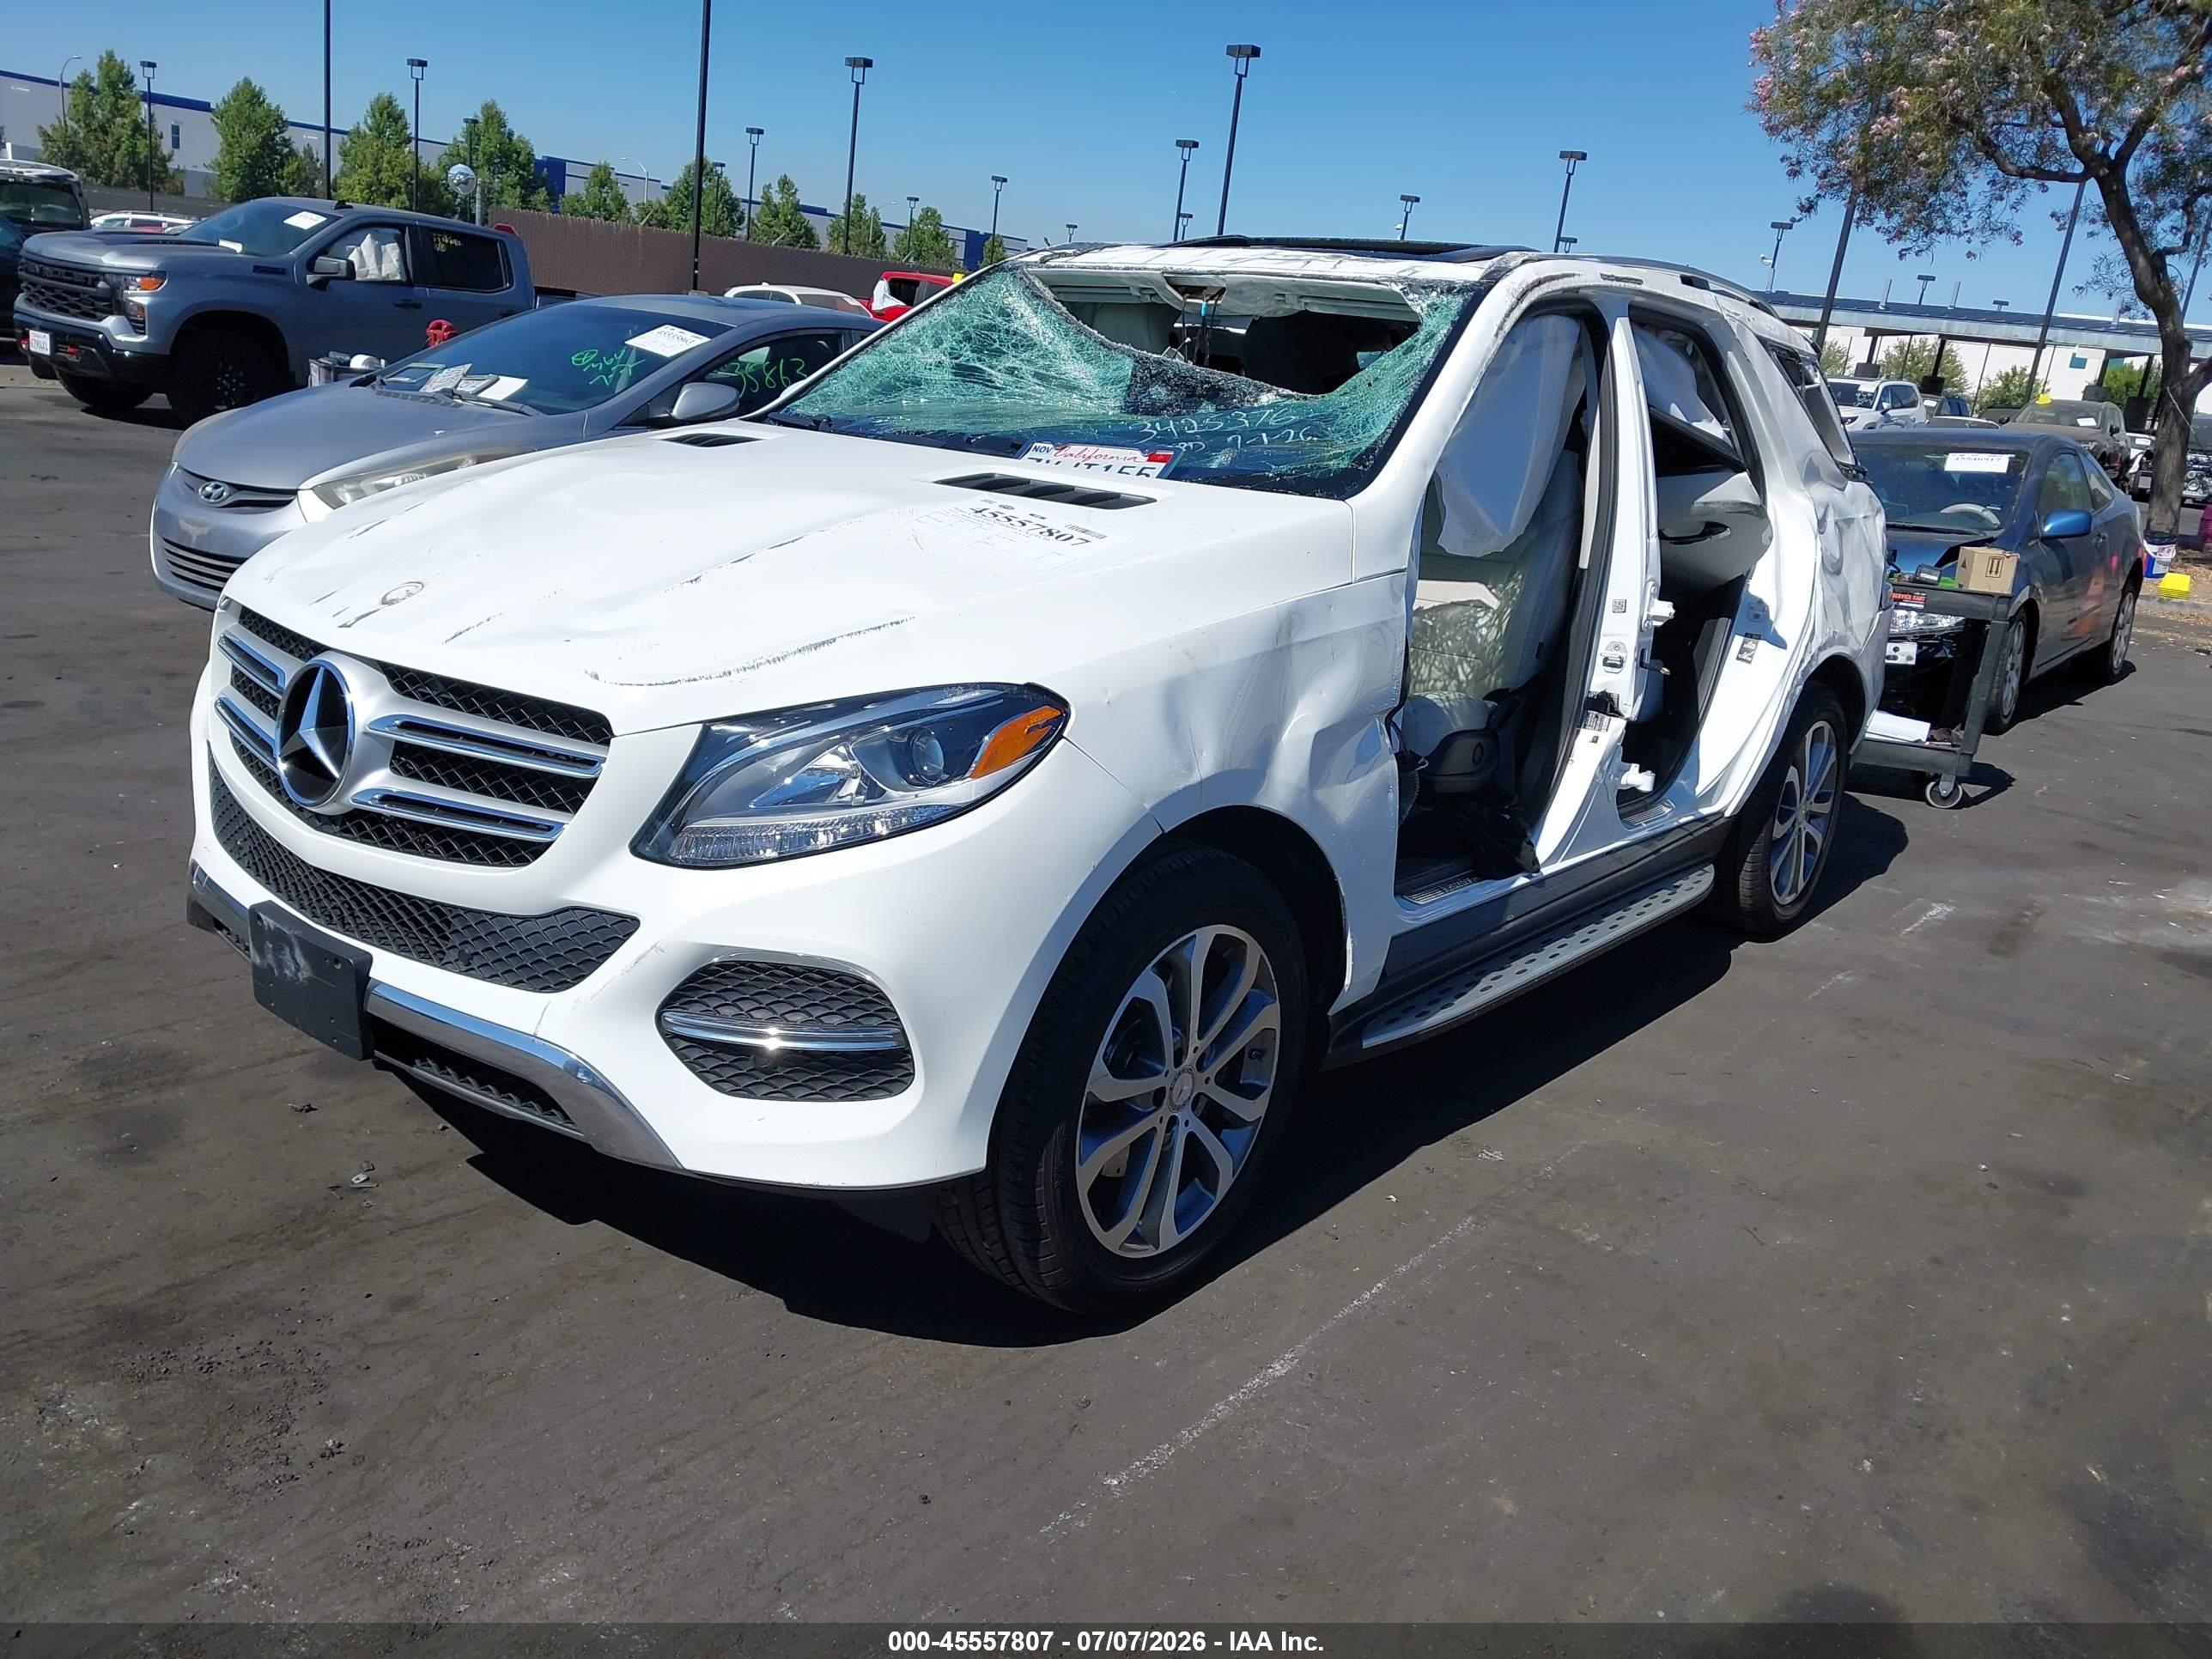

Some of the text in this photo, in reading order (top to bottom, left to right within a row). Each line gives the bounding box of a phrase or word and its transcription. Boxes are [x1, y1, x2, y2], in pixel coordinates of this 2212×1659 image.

[1128, 409, 1296, 444] 3425376
[1032, 443, 1142, 462] NOV California
[969, 507, 1092, 546] 45557807
